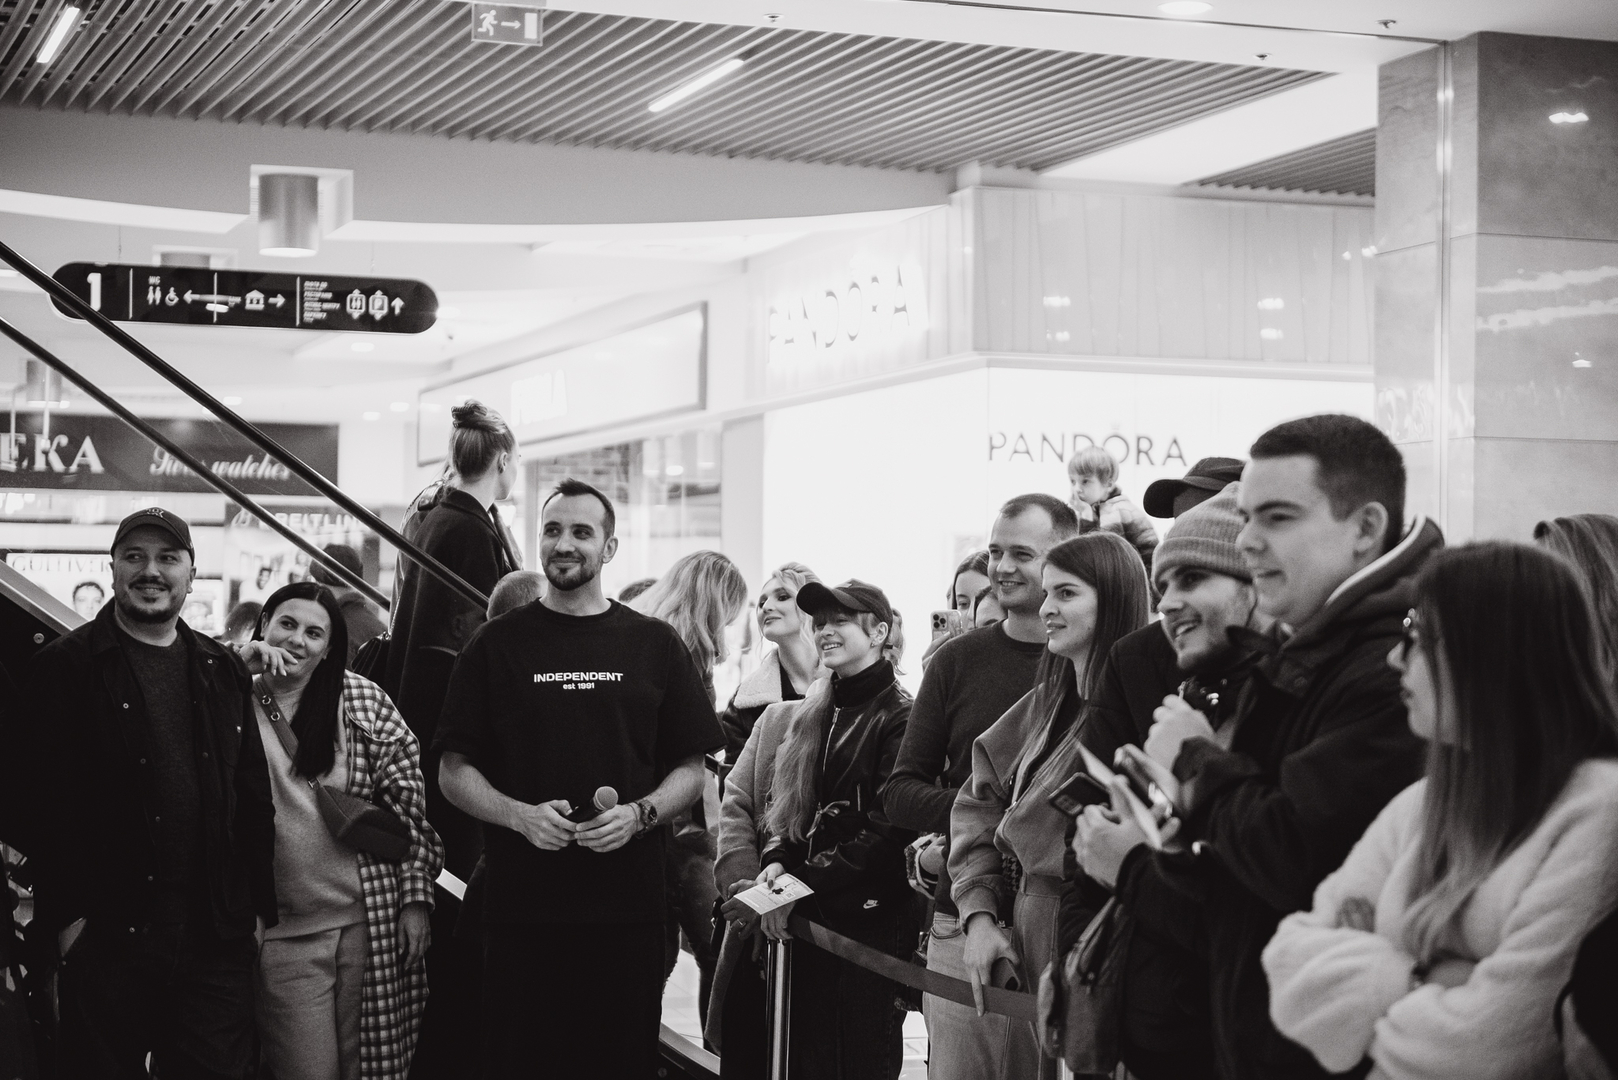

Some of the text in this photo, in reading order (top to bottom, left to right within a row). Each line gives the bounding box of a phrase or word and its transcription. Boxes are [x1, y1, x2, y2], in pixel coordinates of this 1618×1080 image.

[87, 272, 102, 312] 1
[533, 672, 623, 682] INDEPENDENT
[577, 682, 595, 690] 1991
